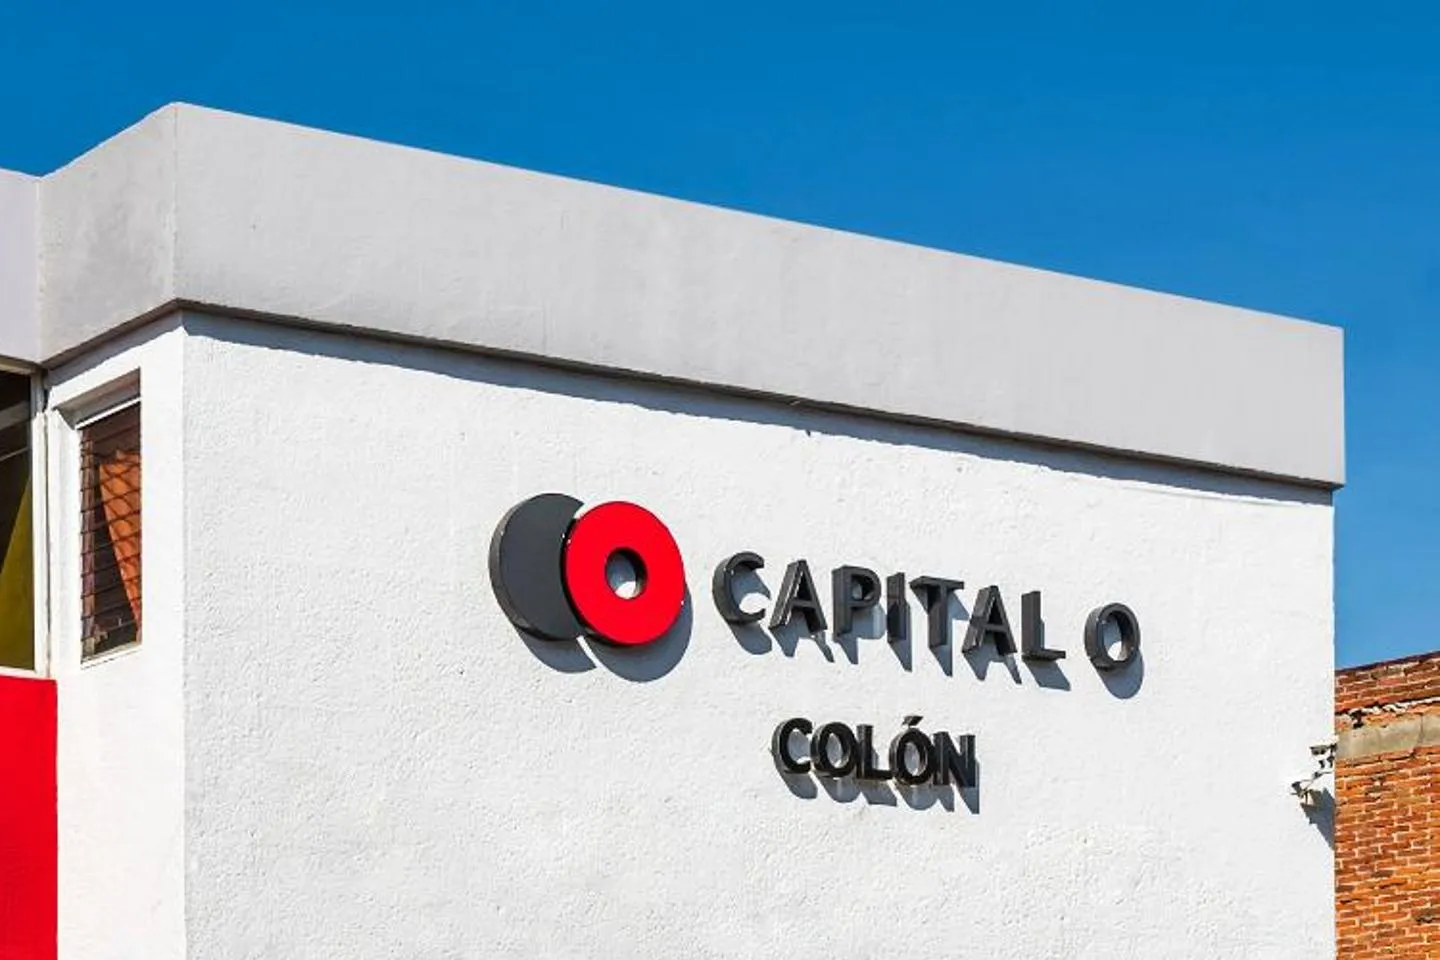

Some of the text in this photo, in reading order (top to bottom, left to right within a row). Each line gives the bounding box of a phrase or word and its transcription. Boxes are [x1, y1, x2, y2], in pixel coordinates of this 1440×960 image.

[711, 551, 1141, 671] CAPITAL O
[771, 715, 976, 787] COLÓN
